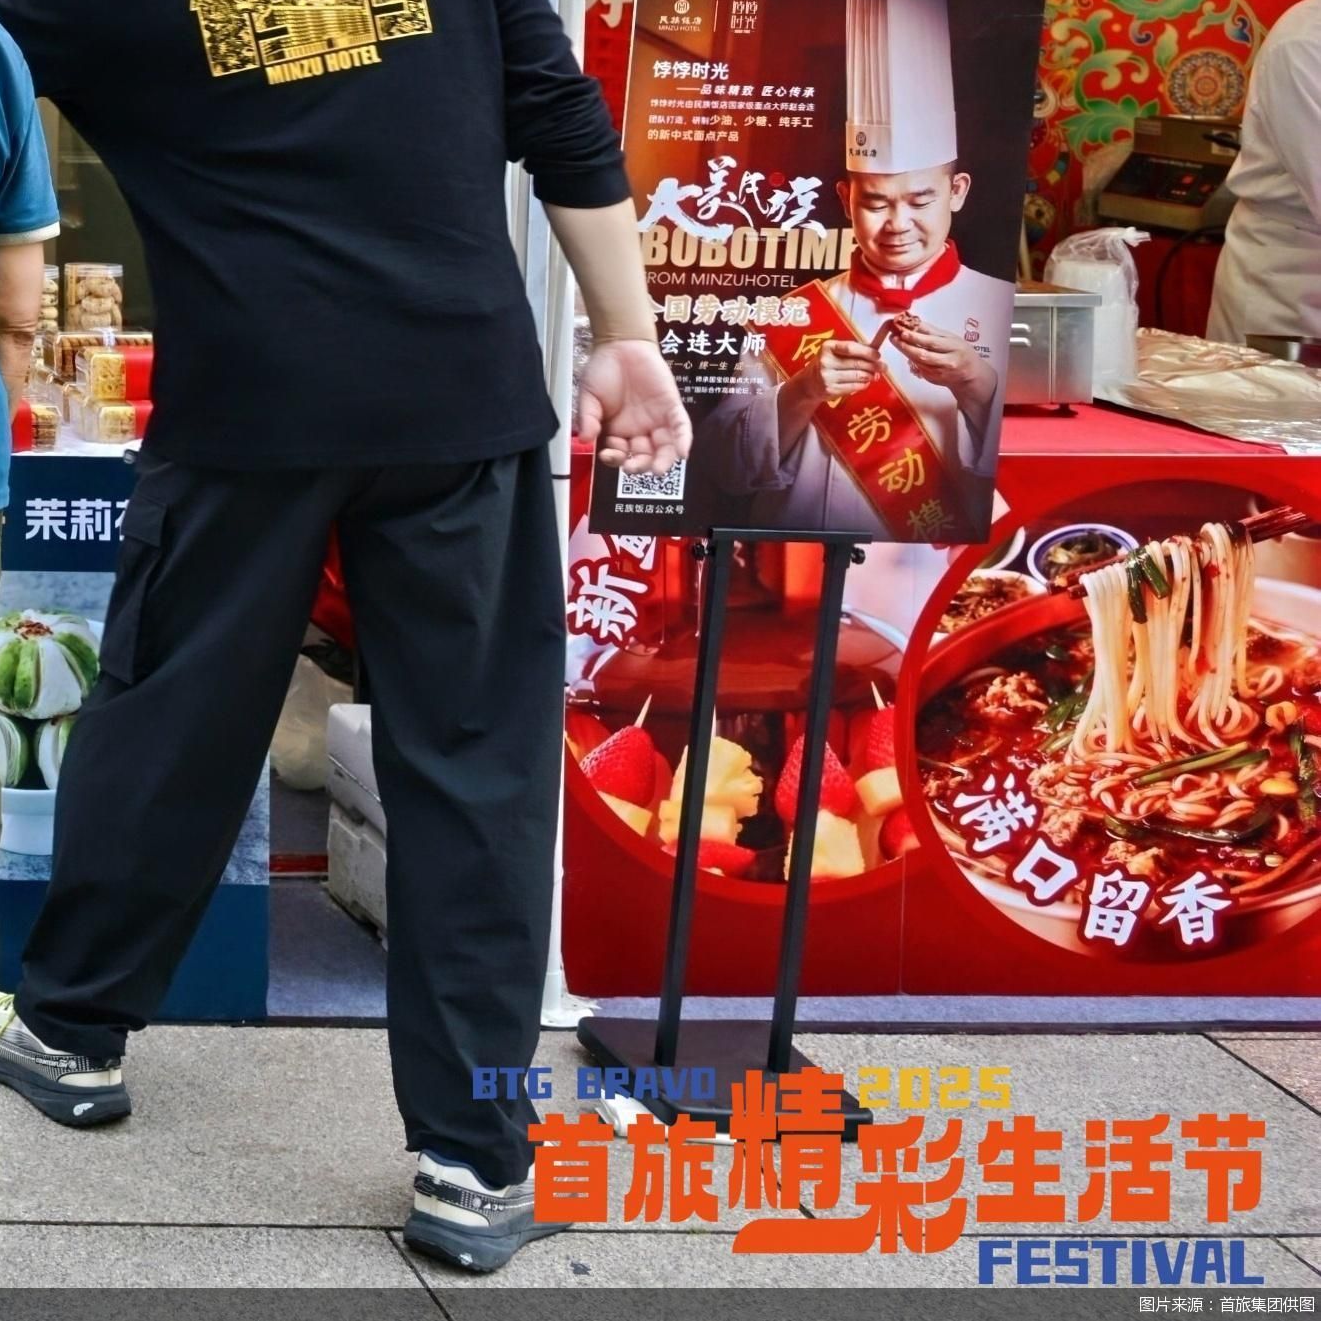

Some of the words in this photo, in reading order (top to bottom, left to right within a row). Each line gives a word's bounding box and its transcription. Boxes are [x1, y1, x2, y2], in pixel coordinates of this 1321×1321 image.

[652, 60, 730, 81] 饽饽时光
[760, 85, 816, 98] 匠心传承
[647, 128, 739, 142] 的新中式面点产品
[690, 272, 799, 289] MINZUHOTEL
[660, 330, 767, 357] 会连大师
[953, 773, 1234, 946] 满口留香
